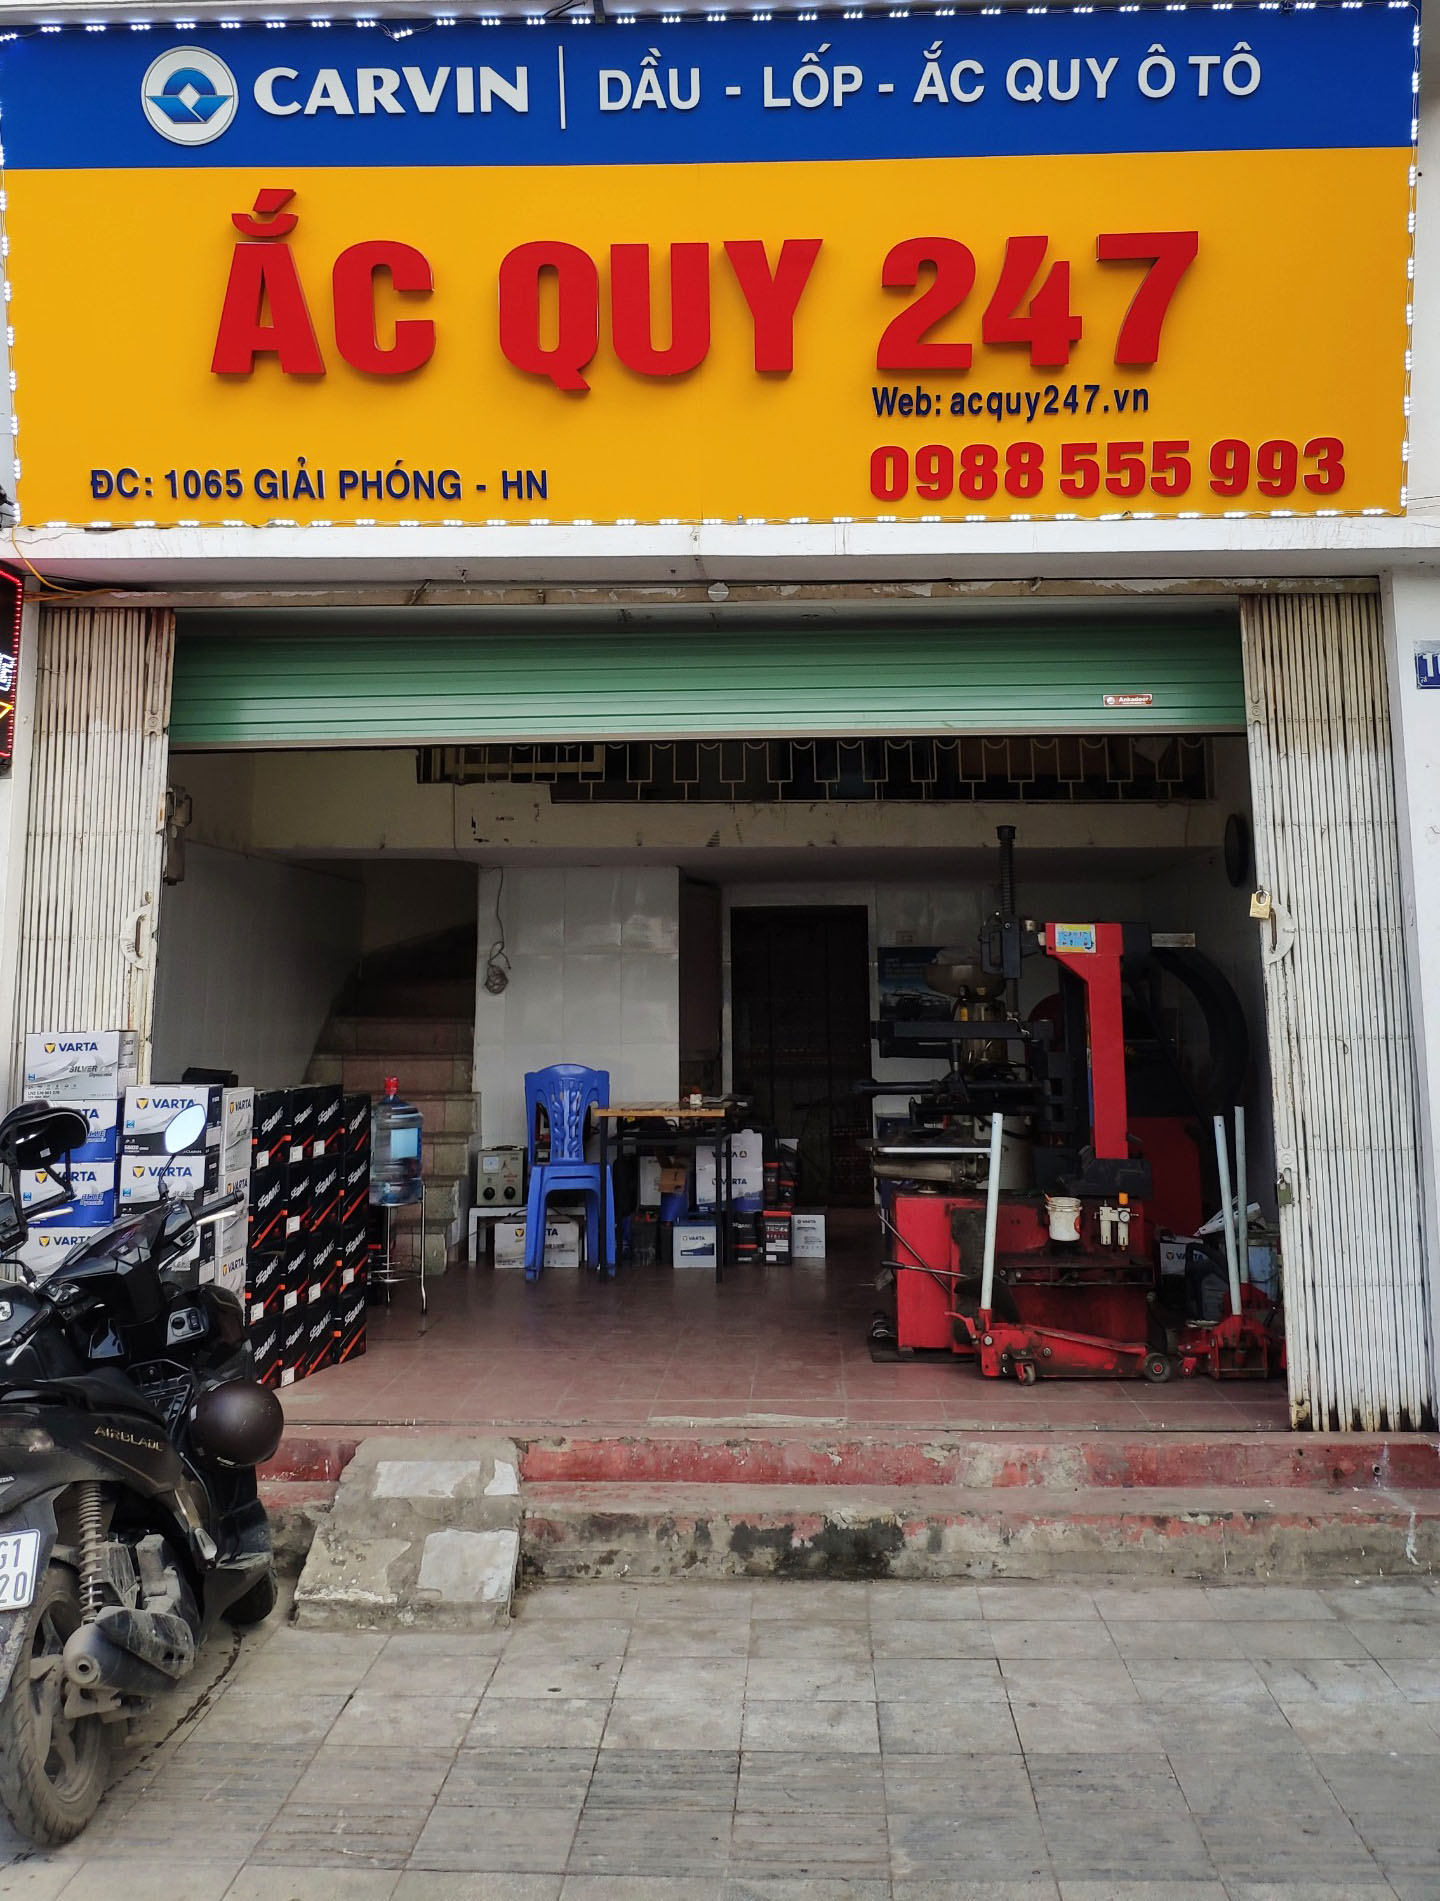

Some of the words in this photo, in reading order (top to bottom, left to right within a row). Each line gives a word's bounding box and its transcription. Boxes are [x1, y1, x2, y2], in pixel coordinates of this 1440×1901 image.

[599, 47, 700, 111] DẦU
[763, 43, 863, 108] LỐP
[913, 41, 985, 103] ẮC
[1006, 57, 1119, 103] QUY
[1138, 43, 1176, 98] Ô
[1189, 41, 1261, 96] TÔ
[254, 66, 529, 115] CARVIN
[211, 188, 436, 376] ẮC
[498, 238, 824, 392] QUY
[876, 230, 1199, 370] 247
[872, 386, 942, 417] Web:
[949, 384, 1149, 422] acquy247.vn
[870, 441, 1044, 501] 0988
[1060, 440, 1192, 498] 555
[1209, 437, 1345, 497] 993
[90, 468, 152, 499] ĐC:
[164, 468, 243, 500] 1065
[254, 456, 325, 500] GIẢI
[339, 459, 462, 500] PHÓNG
[502, 469, 548, 500] HN
[59, 1042, 98, 1052] VARTA
[69, 1065, 98, 1073] SILVER
[152, 1099, 195, 1109] VARTA
[235, 1099, 251, 1111] VARTA
[57, 1171, 97, 1182] RTA
[148, 1166, 192, 1177] VARTA
[54, 1236, 92, 1246] VART
[229, 1257, 244, 1273] VARTA
